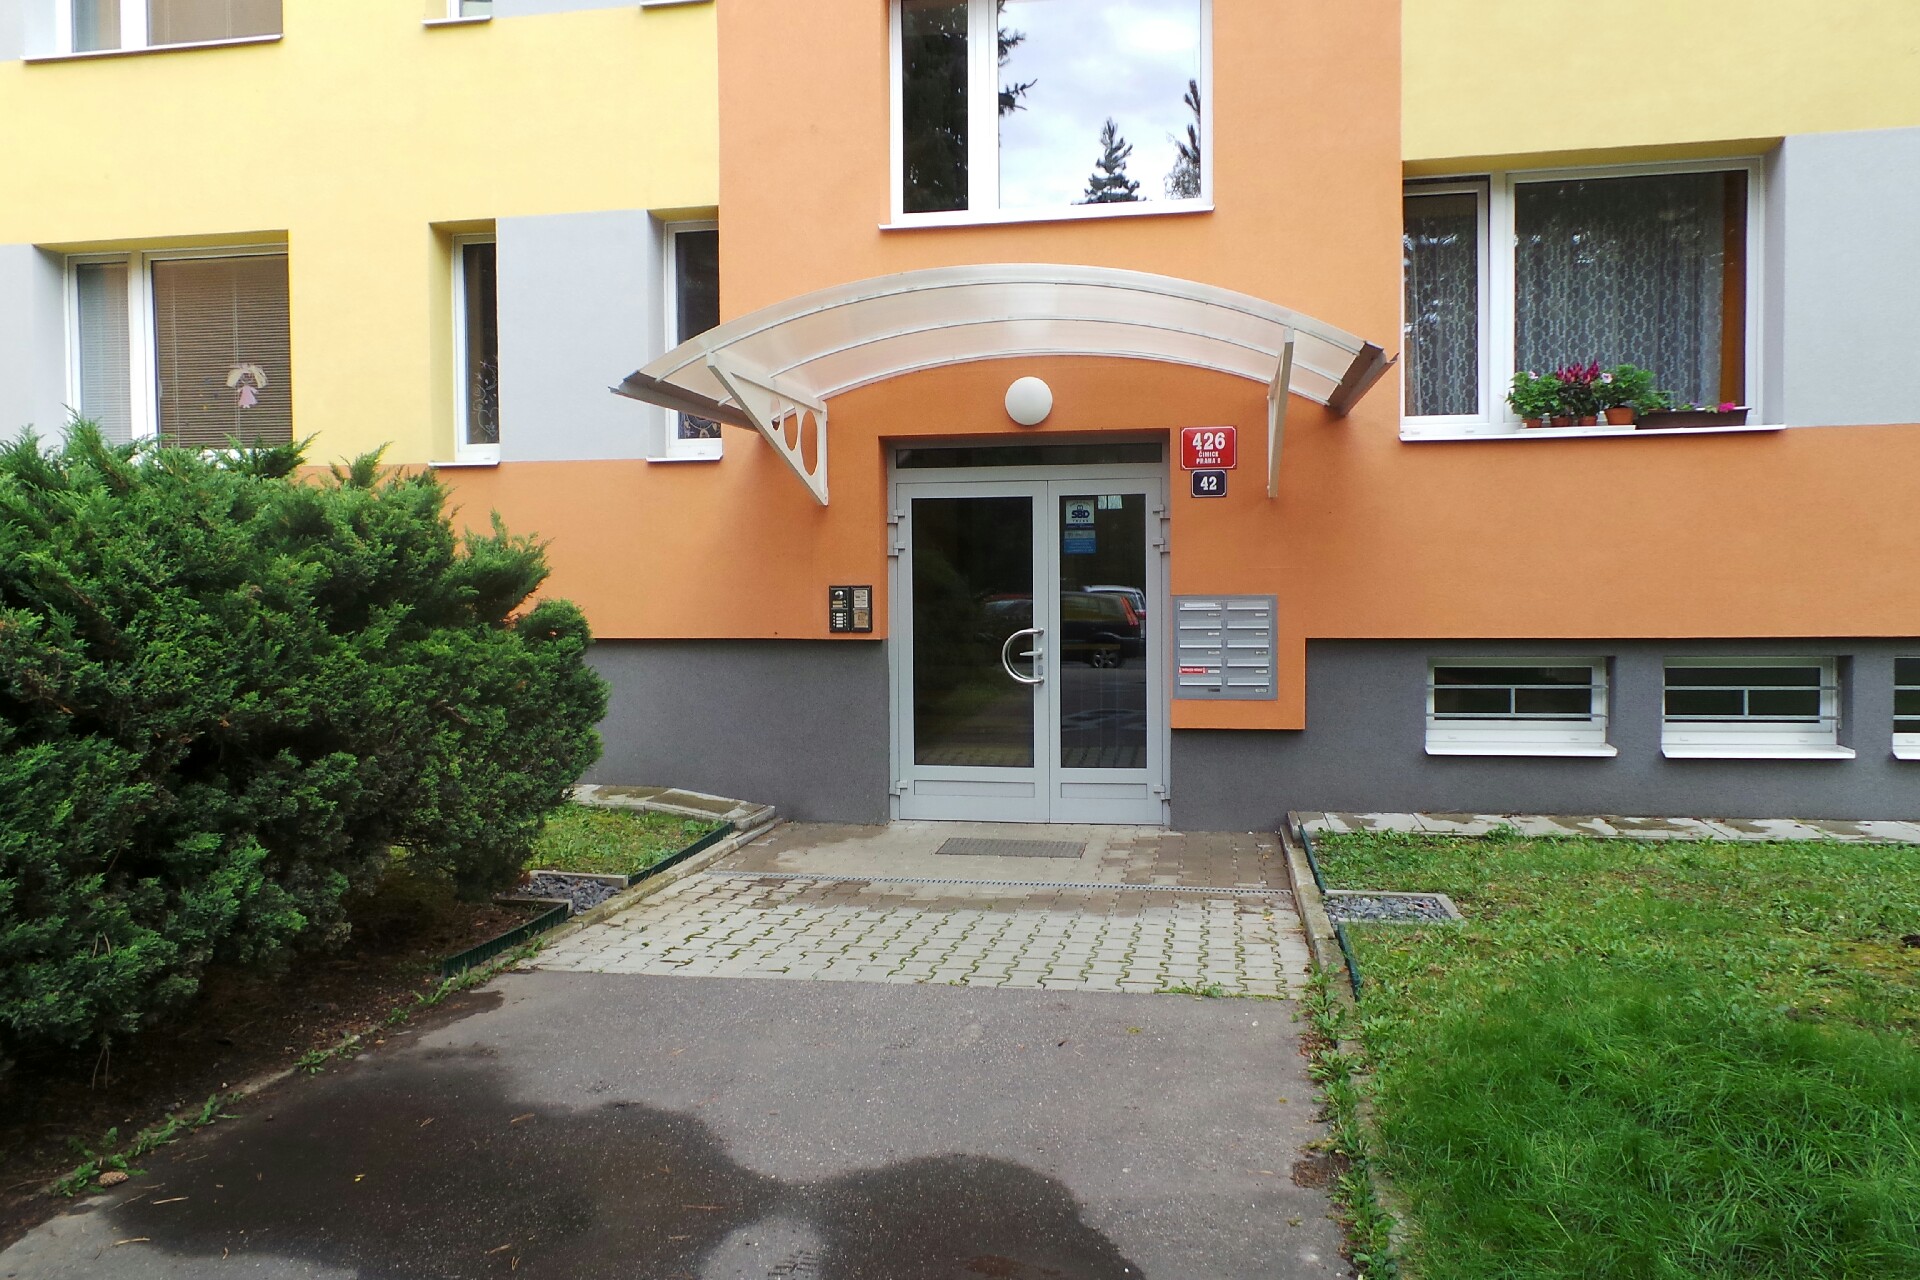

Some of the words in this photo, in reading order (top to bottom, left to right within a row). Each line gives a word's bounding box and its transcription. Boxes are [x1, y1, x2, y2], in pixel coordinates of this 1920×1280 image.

[1192, 432, 1226, 450] 426
[1196, 457, 1216, 465] PRAHA
[1200, 476, 1217, 491] 42
[1071, 509, 1090, 519] SBD
